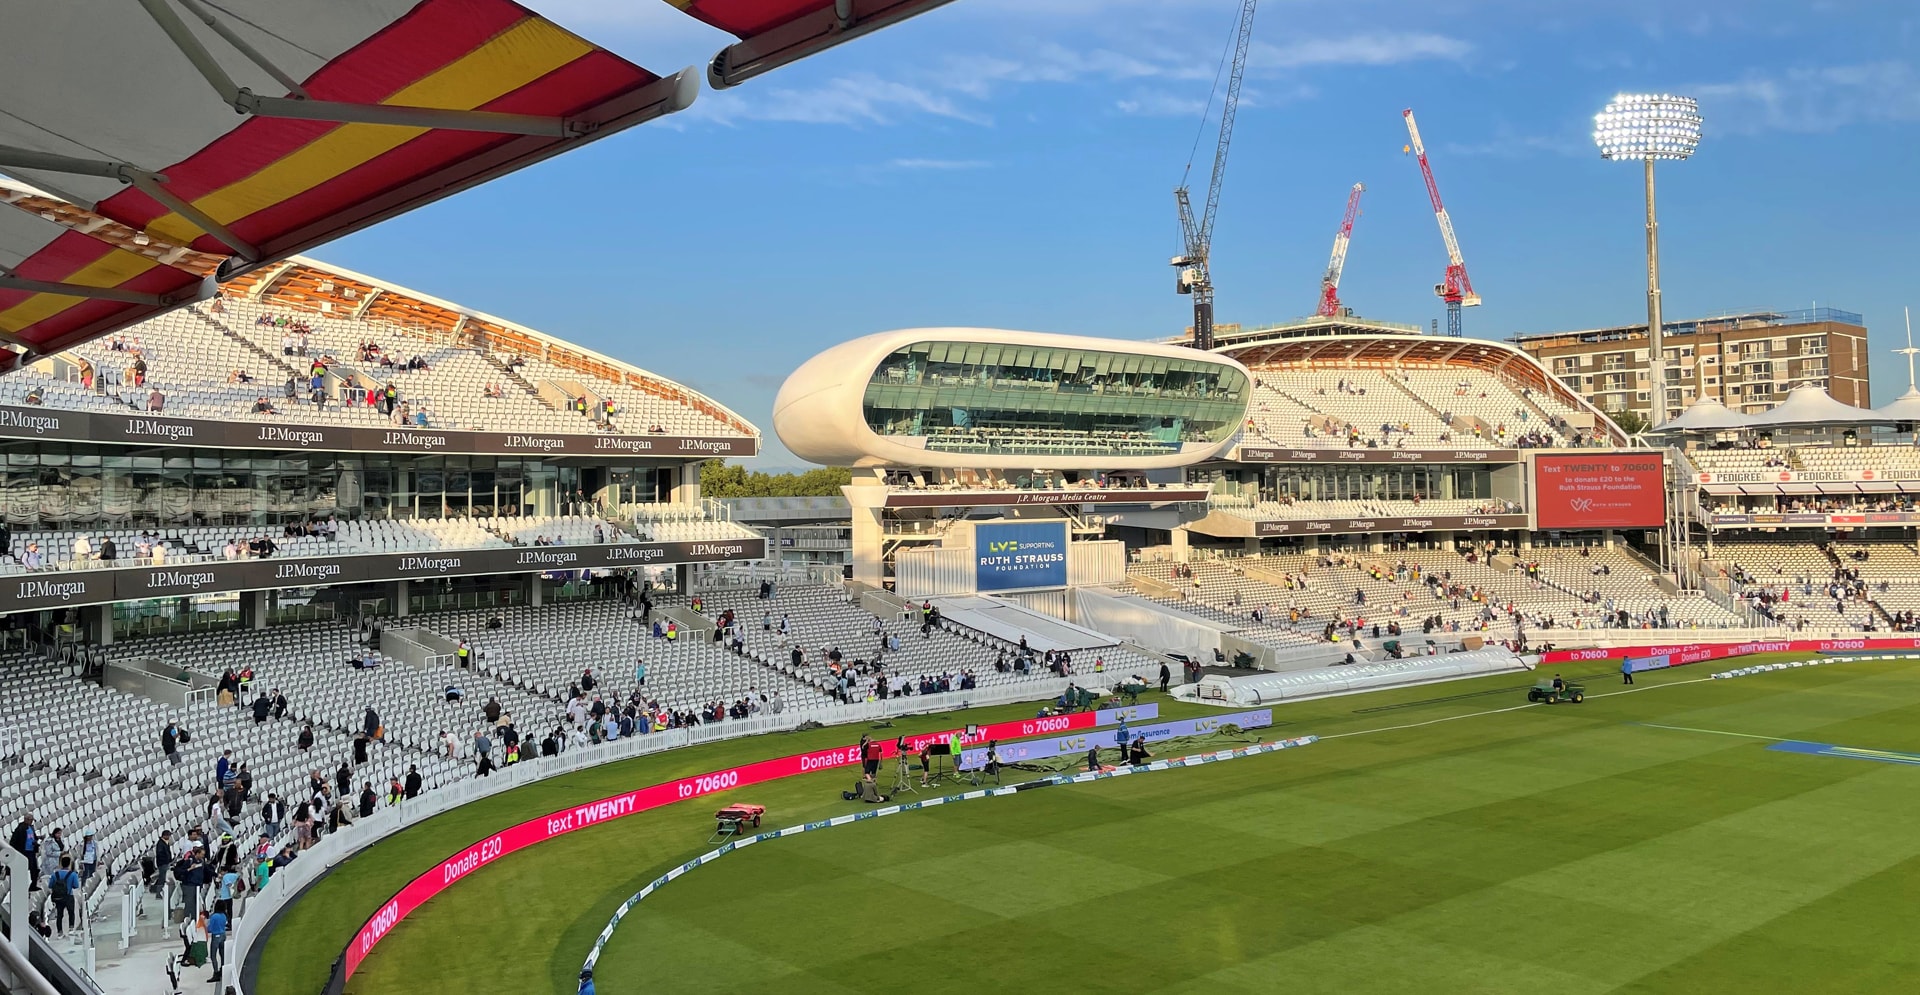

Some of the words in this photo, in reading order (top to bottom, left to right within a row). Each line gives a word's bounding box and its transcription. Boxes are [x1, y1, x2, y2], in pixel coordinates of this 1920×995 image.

[125, 419, 193, 441] J.P.Morgan
[258, 427, 323, 445] J.P.Morgan
[383, 431, 446, 449] J.P.Morgan
[504, 436, 564, 452] J.P.Morgan
[595, 438, 652, 451] J.P.Morgan
[678, 439, 731, 452] J.P.Morgan
[1247, 450, 1274, 460] J.P.Morgan
[1291, 450, 1317, 460] J.P.Morgan
[1338, 451, 1365, 460] J.P.Morgan
[1392, 451, 1422, 460] J.P.Morgan
[1454, 451, 1487, 460] J.P.Morgan
[1563, 464, 1608, 472] TWENTY
[1623, 463, 1656, 471] 70600
[1717, 472, 1762, 482] PEDIGREE
[1797, 472, 1843, 480] PEDIGREE
[1017, 495, 1029, 503] J.P.
[1032, 494, 1059, 503] Morgan
[1262, 522, 1289, 532] J.P.Morgan
[1306, 521, 1331, 530] J.P.Morgan
[1348, 520, 1375, 529] J.P.Morgan
[1402, 518, 1433, 528] J.P.Morgan
[1463, 517, 1497, 527] J.P.Morgan
[689, 544, 742, 557] J.P.Morgan
[1019, 542, 1055, 550] SUPPORTING
[517, 551, 577, 566] J.P.Morgan
[606, 547, 664, 561] J.P.Morgan
[981, 556, 1010, 565] RUTH
[1015, 553, 1064, 563] STRAUSS
[398, 556, 461, 572] J.P.Morgan
[996, 563, 1050, 571] FOUNDATION
[275, 563, 341, 580] J.P.Morgan
[147, 571, 215, 590] J.P.Morgan
[16, 580, 86, 601] J.P.Morgan
[1820, 642, 1830, 650] to
[1832, 641, 1864, 649] 70600
[1571, 652, 1579, 660] to
[1580, 650, 1608, 659] 70600
[1681, 652, 1700, 662] Donate
[1701, 649, 1711, 659] £20
[801, 752, 845, 771] Donate
[848, 747, 863, 762] £2
[1023, 722, 1034, 735] to
[1035, 717, 1069, 732] 70600
[444, 850, 479, 883] Donate
[482, 837, 502, 862] £20
[547, 813, 573, 835] text
[576, 795, 636, 826] TWENTY
[678, 783, 693, 798] to
[695, 771, 738, 793] 70600
[362, 932, 371, 953] to
[371, 900, 398, 943] 70600
